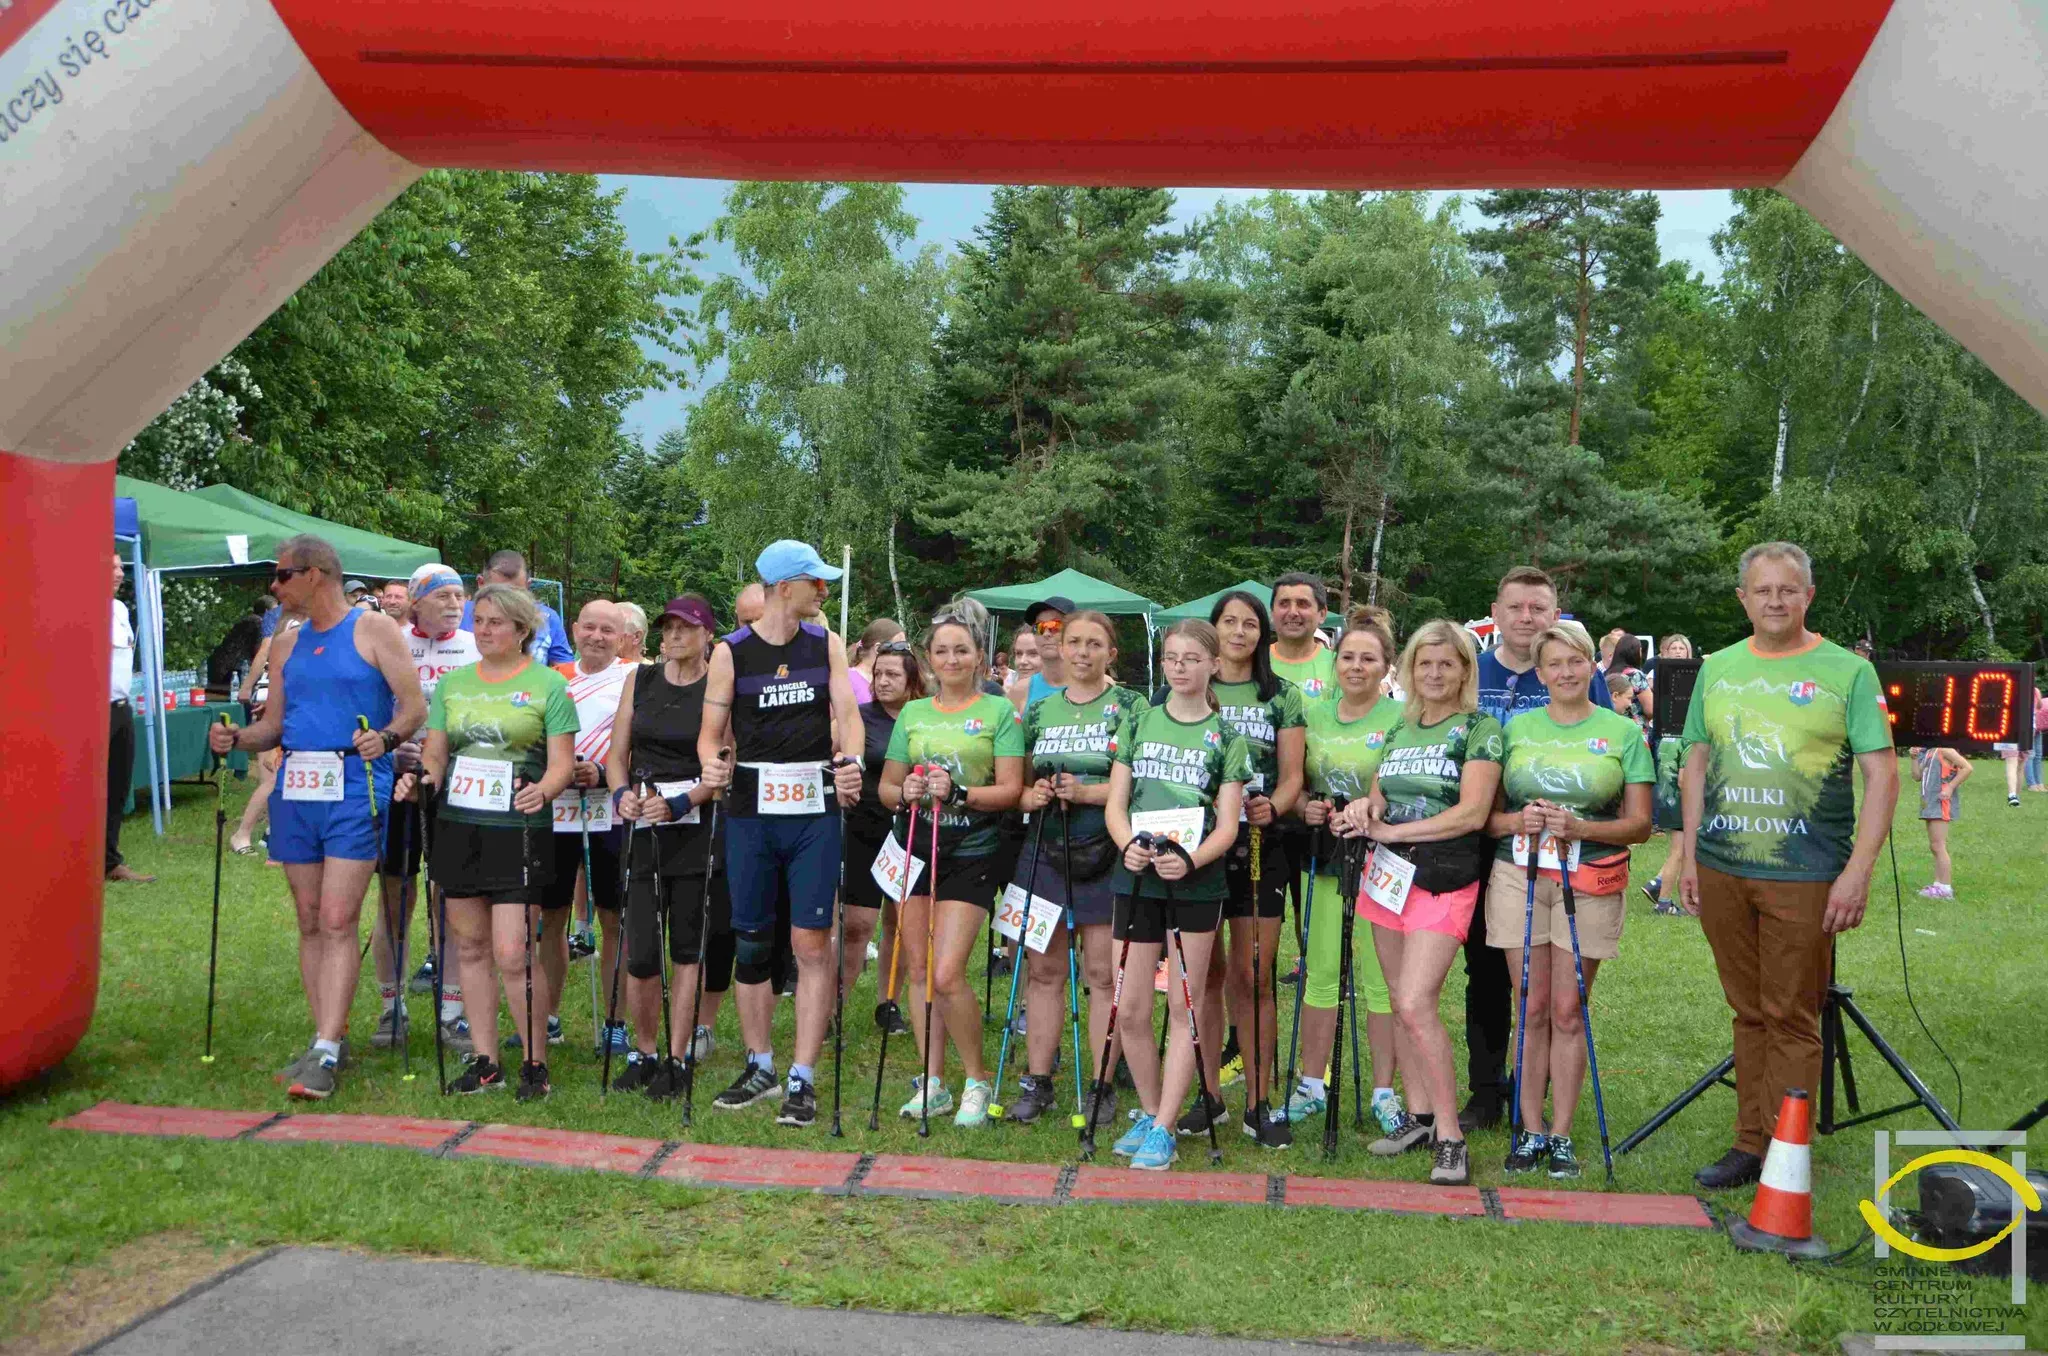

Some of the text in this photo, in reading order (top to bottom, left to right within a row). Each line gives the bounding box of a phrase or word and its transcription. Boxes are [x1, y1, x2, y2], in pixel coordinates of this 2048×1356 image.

[57, 30, 110, 77] się
[759, 687, 815, 708] LAKERS
[762, 681, 808, 694] LOS ANGELES
[1045, 721, 1108, 740] WILKI
[1142, 741, 1208, 768] WILKI
[1388, 743, 1448, 761] WILKI
[286, 770, 320, 789] 333
[452, 775, 485, 797] 271
[762, 782, 805, 802] 338
[1724, 786, 1785, 805] WILKI
[1367, 861, 1394, 890] 327
